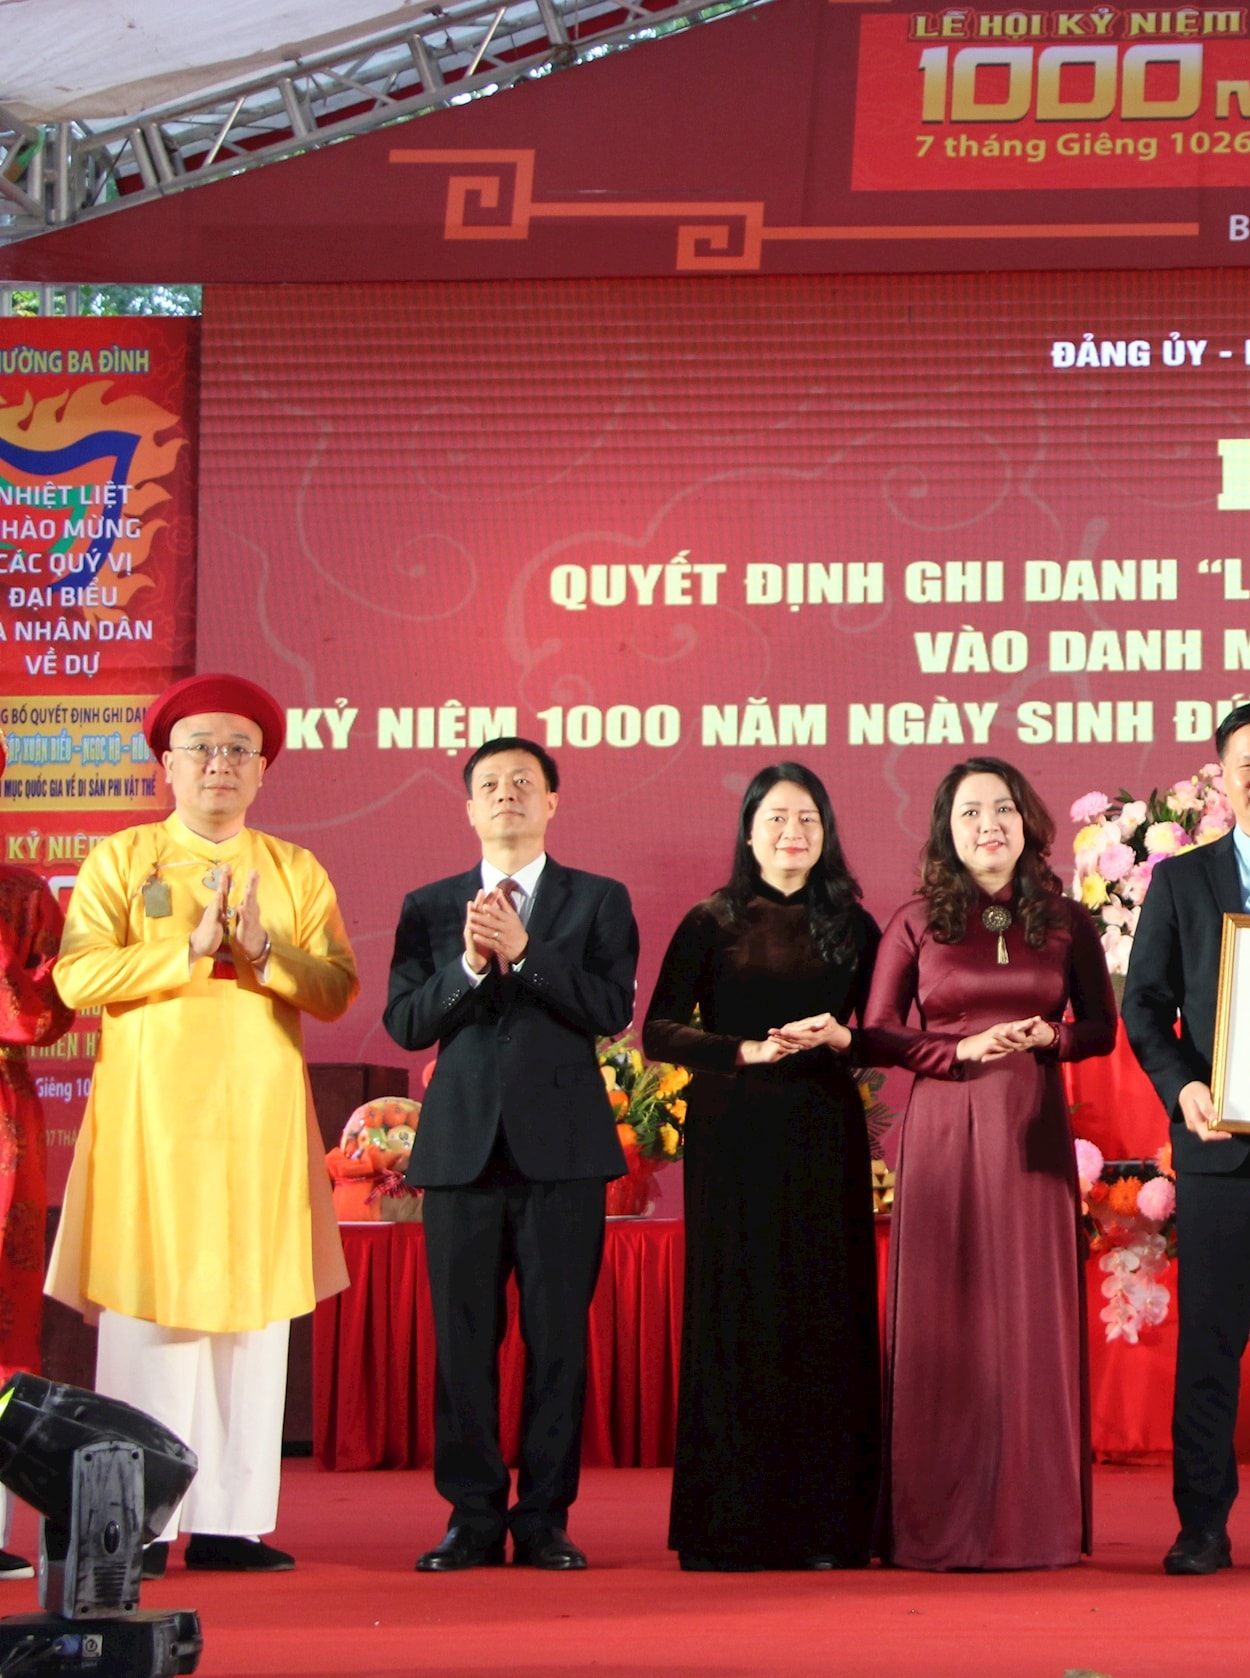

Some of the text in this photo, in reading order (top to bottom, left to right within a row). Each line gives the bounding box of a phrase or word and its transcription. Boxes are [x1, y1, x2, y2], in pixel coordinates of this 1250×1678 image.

[915, 7, 1242, 39] LỄ HỘI KỶ NIỆM
[918, 43, 1204, 123] 1000
[915, 135, 935, 157] 7
[944, 133, 1047, 162] tháng
[1057, 130, 1158, 161] Giêng
[0, 345, 150, 374] ƯỜNG BA ĐÌNH
[1051, 332, 1151, 368] ĐẢNG
[1162, 331, 1207, 366] ỦY
[0, 480, 134, 509] NHIỆT LIỆT
[1, 514, 141, 540] HÀO MỪNG
[0, 548, 133, 575] CÁC QUÝ VỊ
[9, 577, 119, 611] ĐẠI BIỂU
[550, 549, 727, 611] QUYẾT
[744, 561, 884, 613] ĐỊNH
[905, 560, 1004, 604] GHI
[1025, 559, 1178, 602] DANH
[15, 616, 91, 641] NHÂN
[98, 616, 153, 641] DÂN
[25, 647, 101, 678] VỀ DỰ
[914, 624, 1028, 673] VÀO
[1049, 629, 1202, 672] DANH
[30, 703, 69, 726] QUYẾT
[70, 707, 100, 728] ĐỊNH
[103, 706, 123, 724] GHI
[286, 697, 359, 750] KỶ
[377, 699, 518, 756] NIỆM
[536, 704, 682, 748] 1000
[702, 696, 828, 747] NĂM
[848, 695, 999, 746] NGÀY
[1017, 701, 1154, 745] SINH
[78, 778, 87, 797] DI
[108, 778, 122, 797] PHI
[8, 830, 105, 862] KỶ NIỆ
